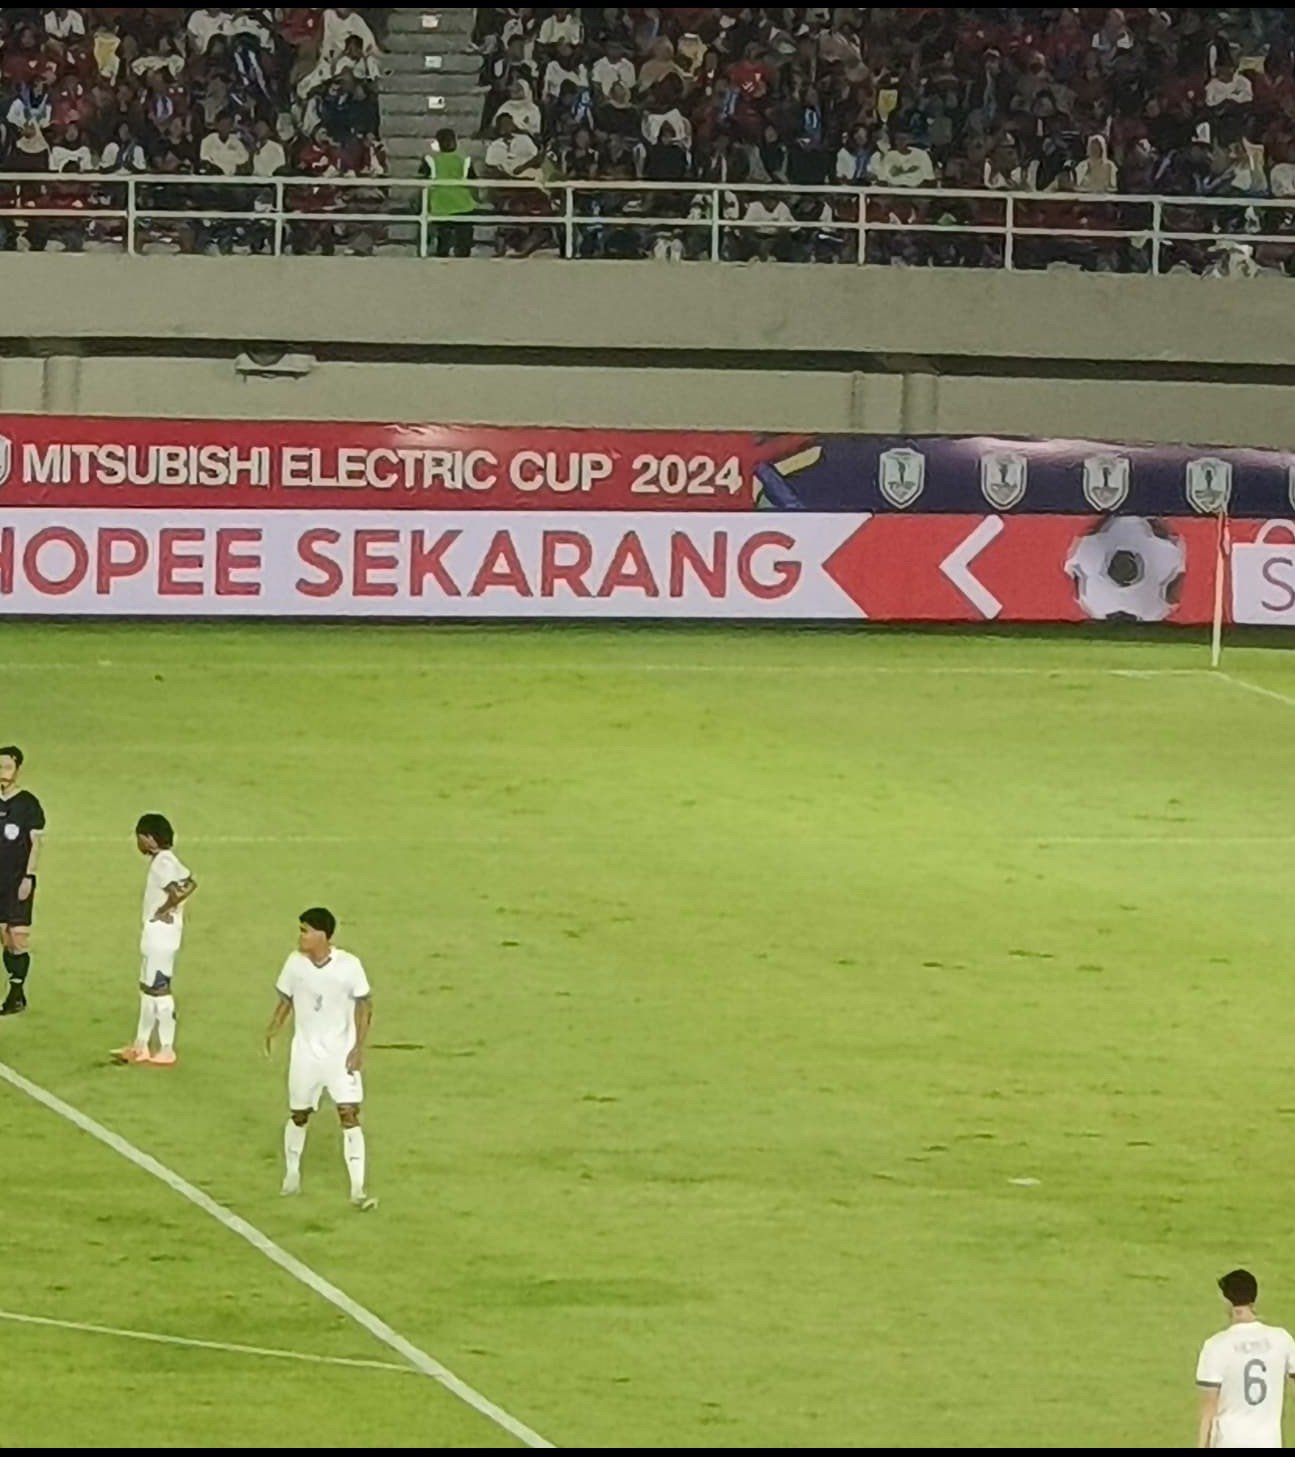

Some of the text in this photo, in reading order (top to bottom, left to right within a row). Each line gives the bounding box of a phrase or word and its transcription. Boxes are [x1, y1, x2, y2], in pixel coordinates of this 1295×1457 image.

[22, 443, 743, 495] MITSUBISHI ELECTRIC CUP 2024
[296, 529, 802, 599] SEKARANG
[1244, 1358, 1267, 1406] 6
